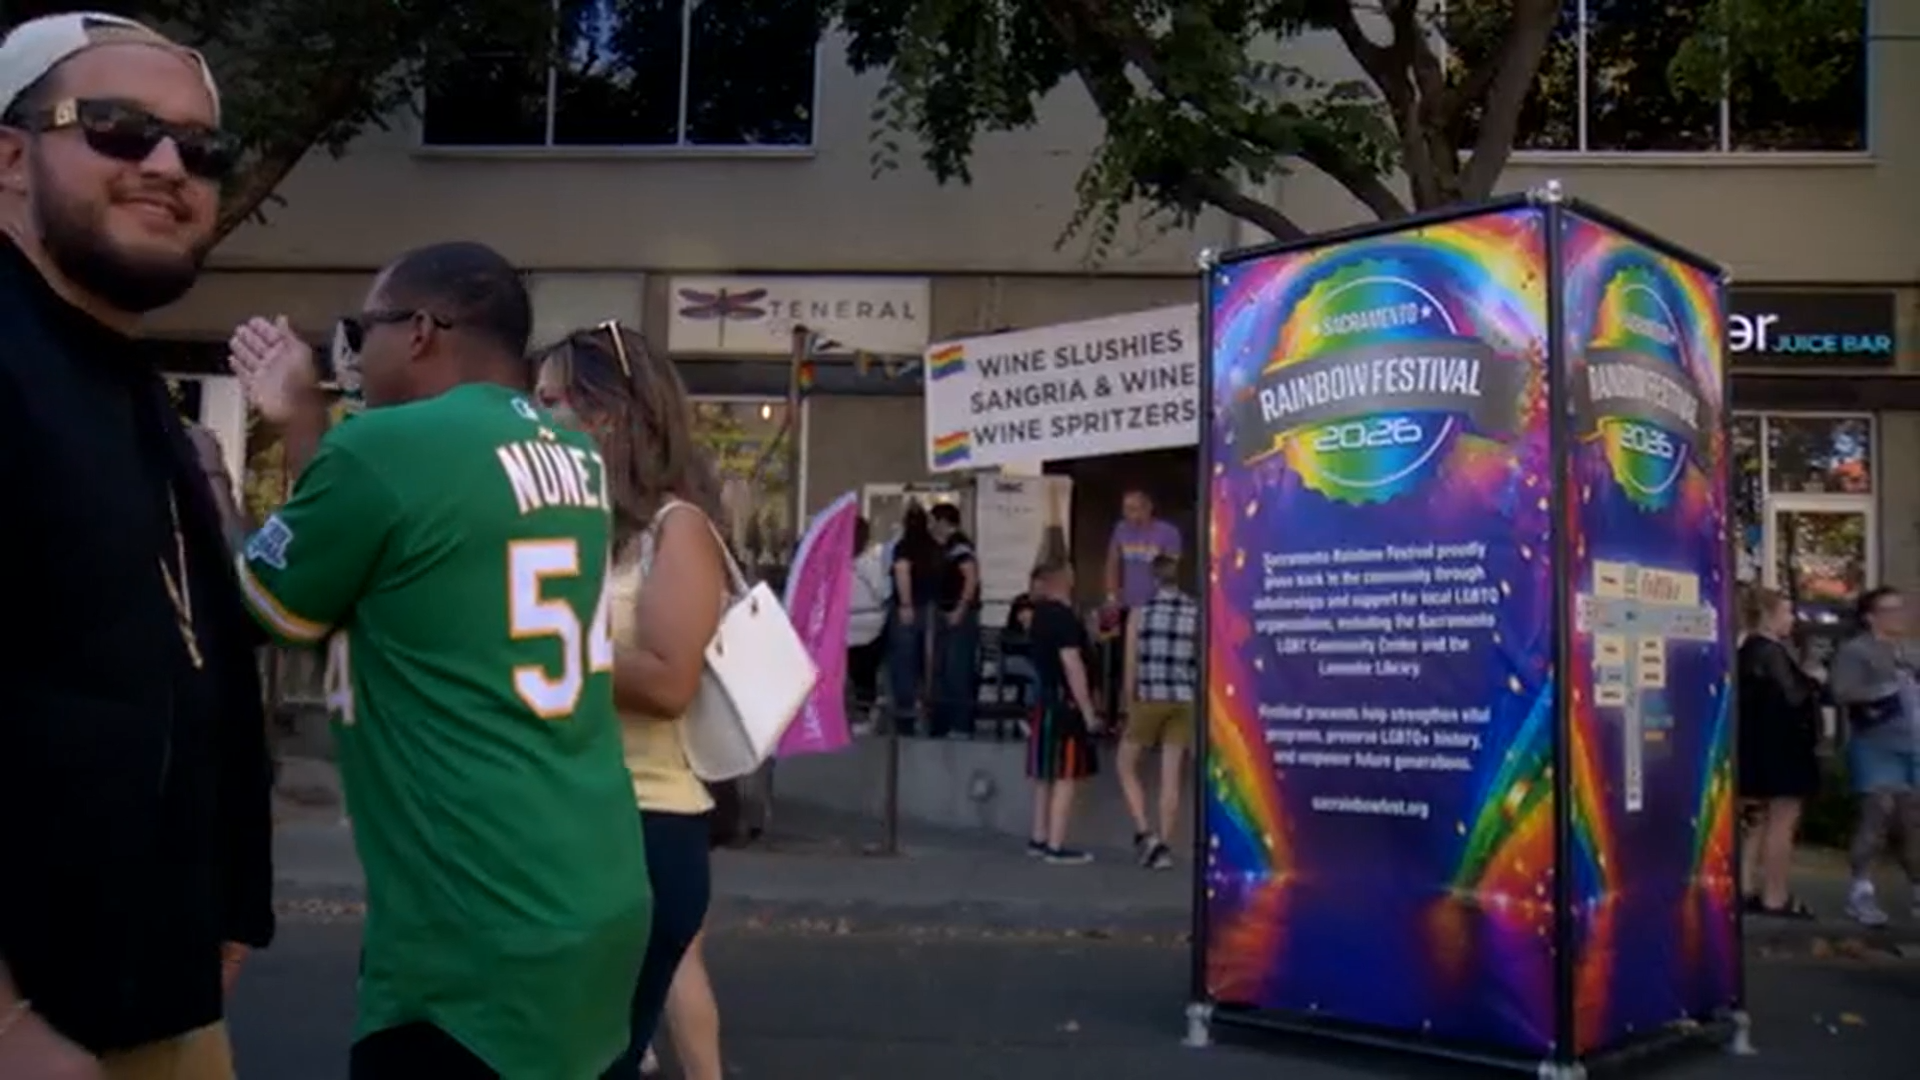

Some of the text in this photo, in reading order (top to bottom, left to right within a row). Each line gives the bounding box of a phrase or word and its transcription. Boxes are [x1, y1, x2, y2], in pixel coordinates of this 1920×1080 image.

[768, 300, 915, 319] TENERAL
[1322, 302, 1419, 336] SACRAMENTO
[976, 329, 1184, 379] WINE SLUSHIES
[1771, 334, 1837, 352] JUICE
[1842, 334, 1892, 353] BAR
[970, 363, 1196, 414] SANGRIA & WINE
[1259, 356, 1482, 422] RAINBOW FESTIVAL
[973, 401, 1197, 446] WINE SPRITZERS
[1314, 418, 1423, 451] 2026
